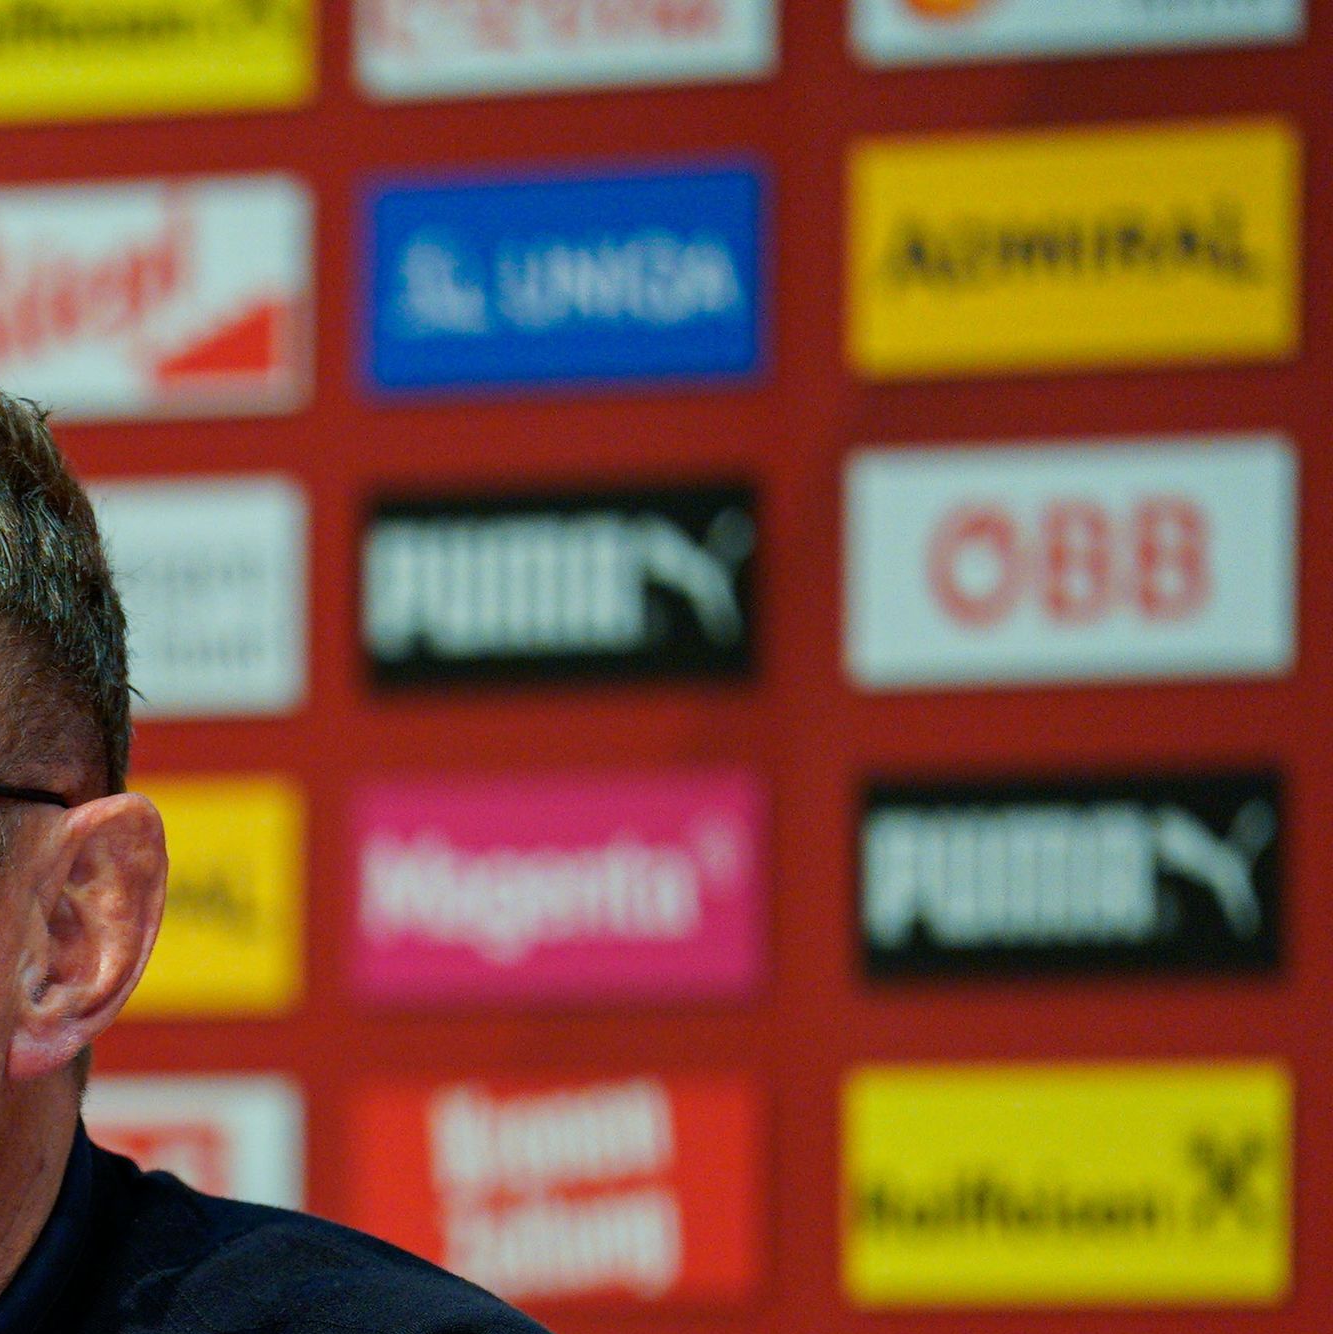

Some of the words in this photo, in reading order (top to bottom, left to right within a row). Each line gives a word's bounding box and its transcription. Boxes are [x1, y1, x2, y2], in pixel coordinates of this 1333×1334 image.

[361, 830, 701, 966] Magenta
[861, 806, 1155, 946] PUMA
[851, 1165, 1175, 1244] Raiffeisen
